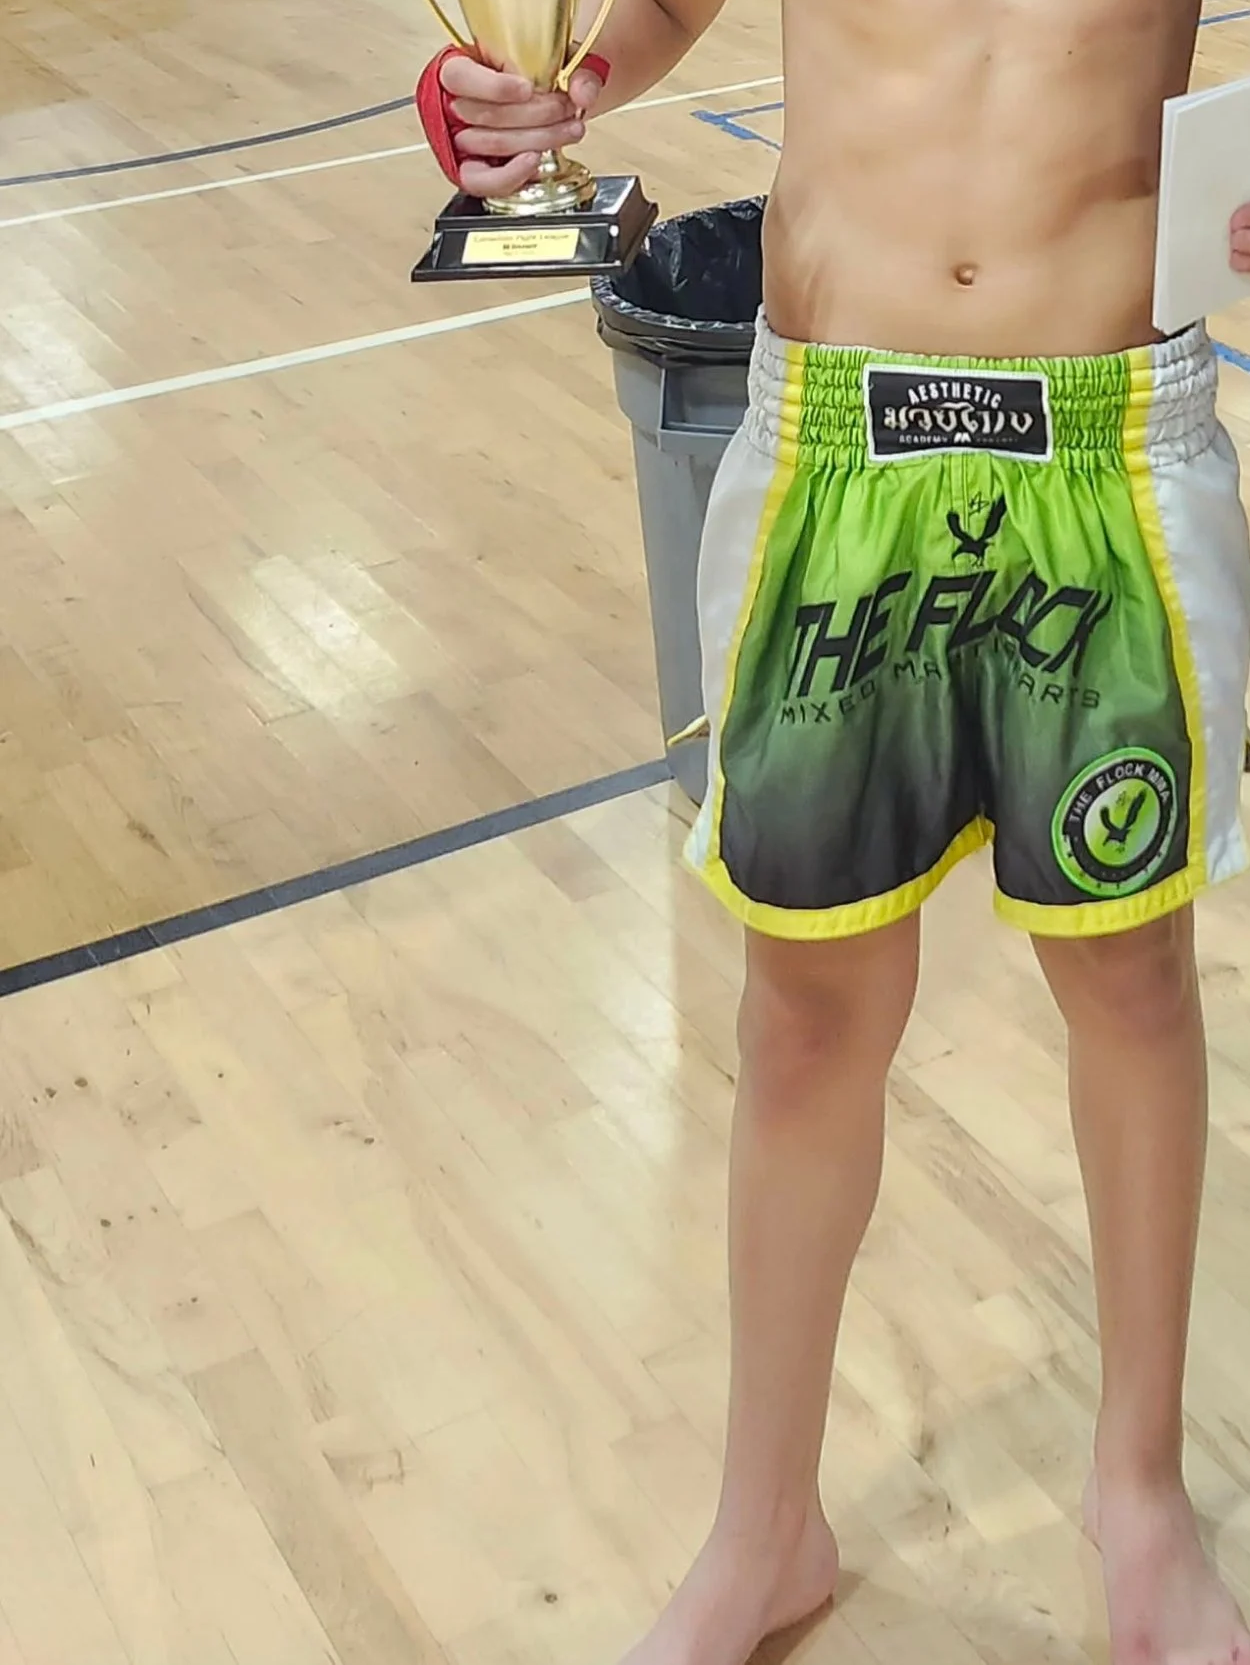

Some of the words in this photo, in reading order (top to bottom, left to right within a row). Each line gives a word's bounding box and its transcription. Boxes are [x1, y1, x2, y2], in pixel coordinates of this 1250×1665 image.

[907, 381, 1003, 409] AESTHETIC
[899, 434, 948, 445] ACADEMY
[783, 570, 913, 701] THE
[780, 679, 877, 725] MIXED
[1068, 790, 1093, 822] THE
[1095, 762, 1146, 790] FLOCK
[1147, 768, 1171, 804] MMA
